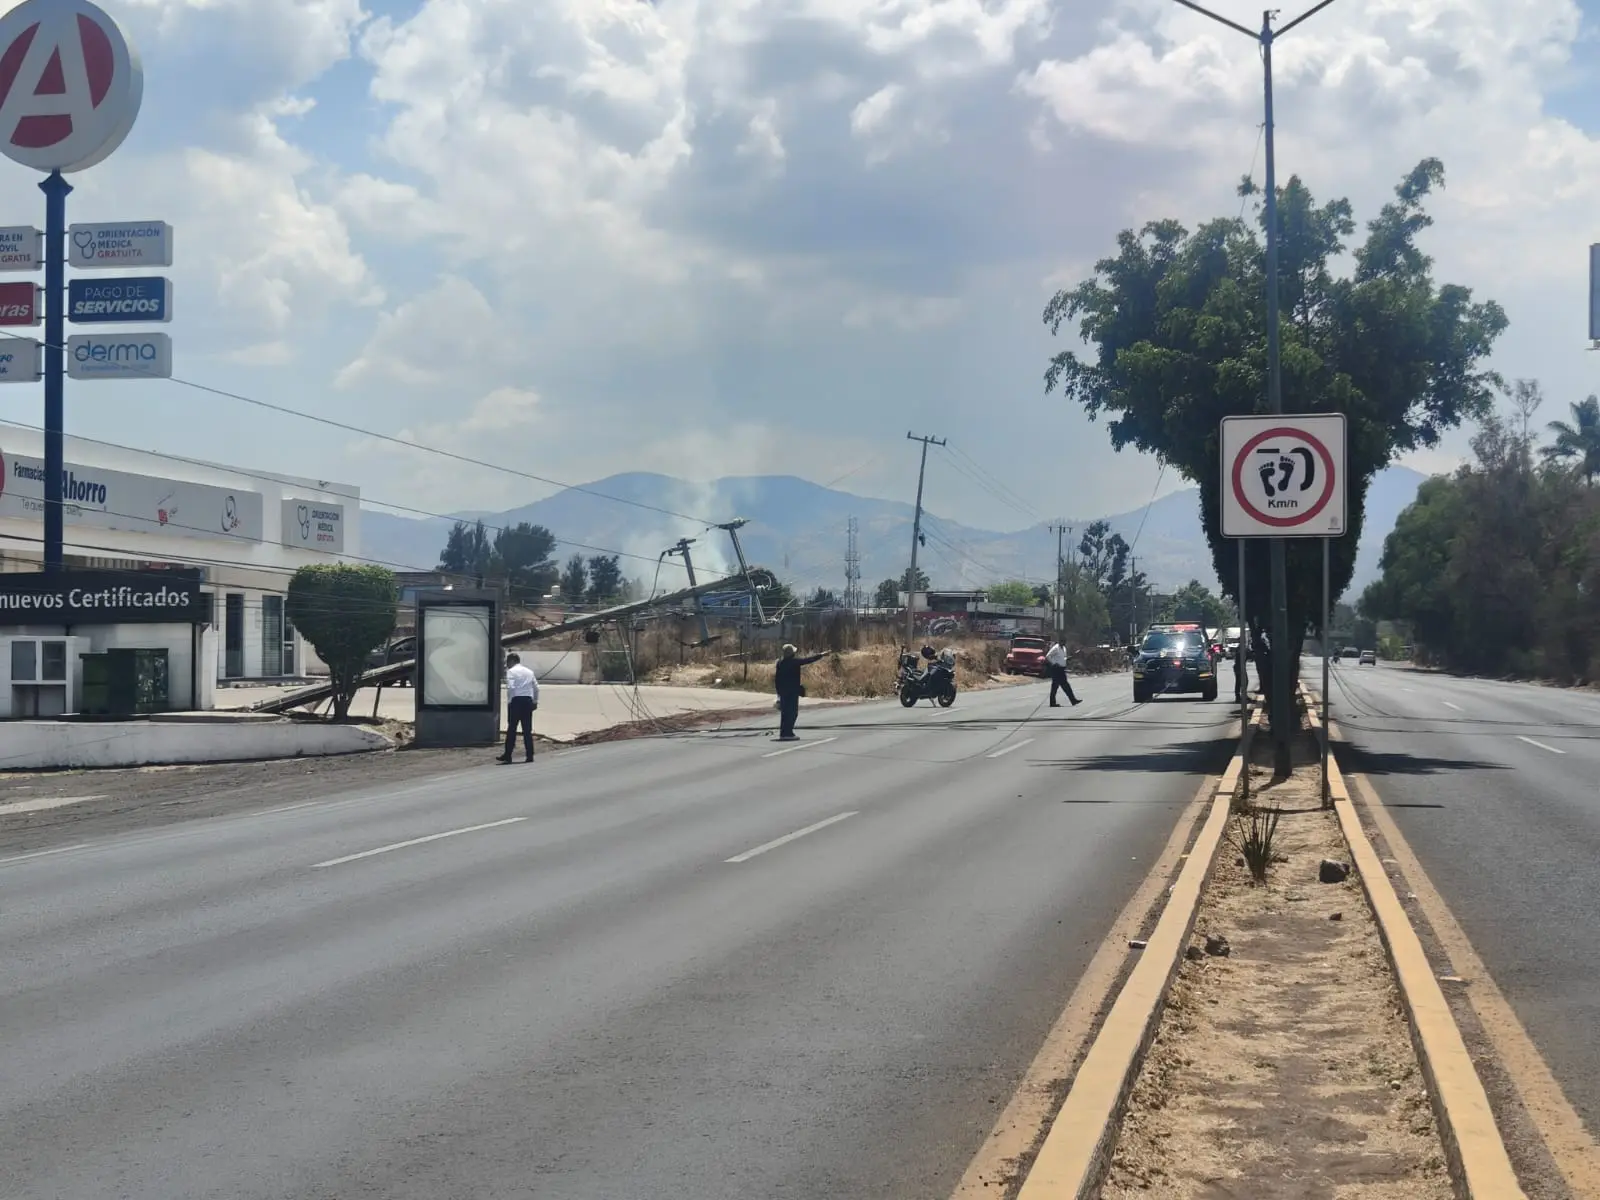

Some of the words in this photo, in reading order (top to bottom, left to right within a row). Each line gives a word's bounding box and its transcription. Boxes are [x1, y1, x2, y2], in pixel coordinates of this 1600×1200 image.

[12, 232, 23, 241] EN
[1, 254, 31, 263] GRATIS
[97, 249, 143, 258] GRATUITA
[85, 286, 122, 298] PAGO
[126, 286, 146, 297] DE
[74, 299, 160, 314] SERVICIOS
[75, 340, 156, 362] derma
[0, 593, 63, 609] nuevos
[69, 586, 190, 608] Certificados
